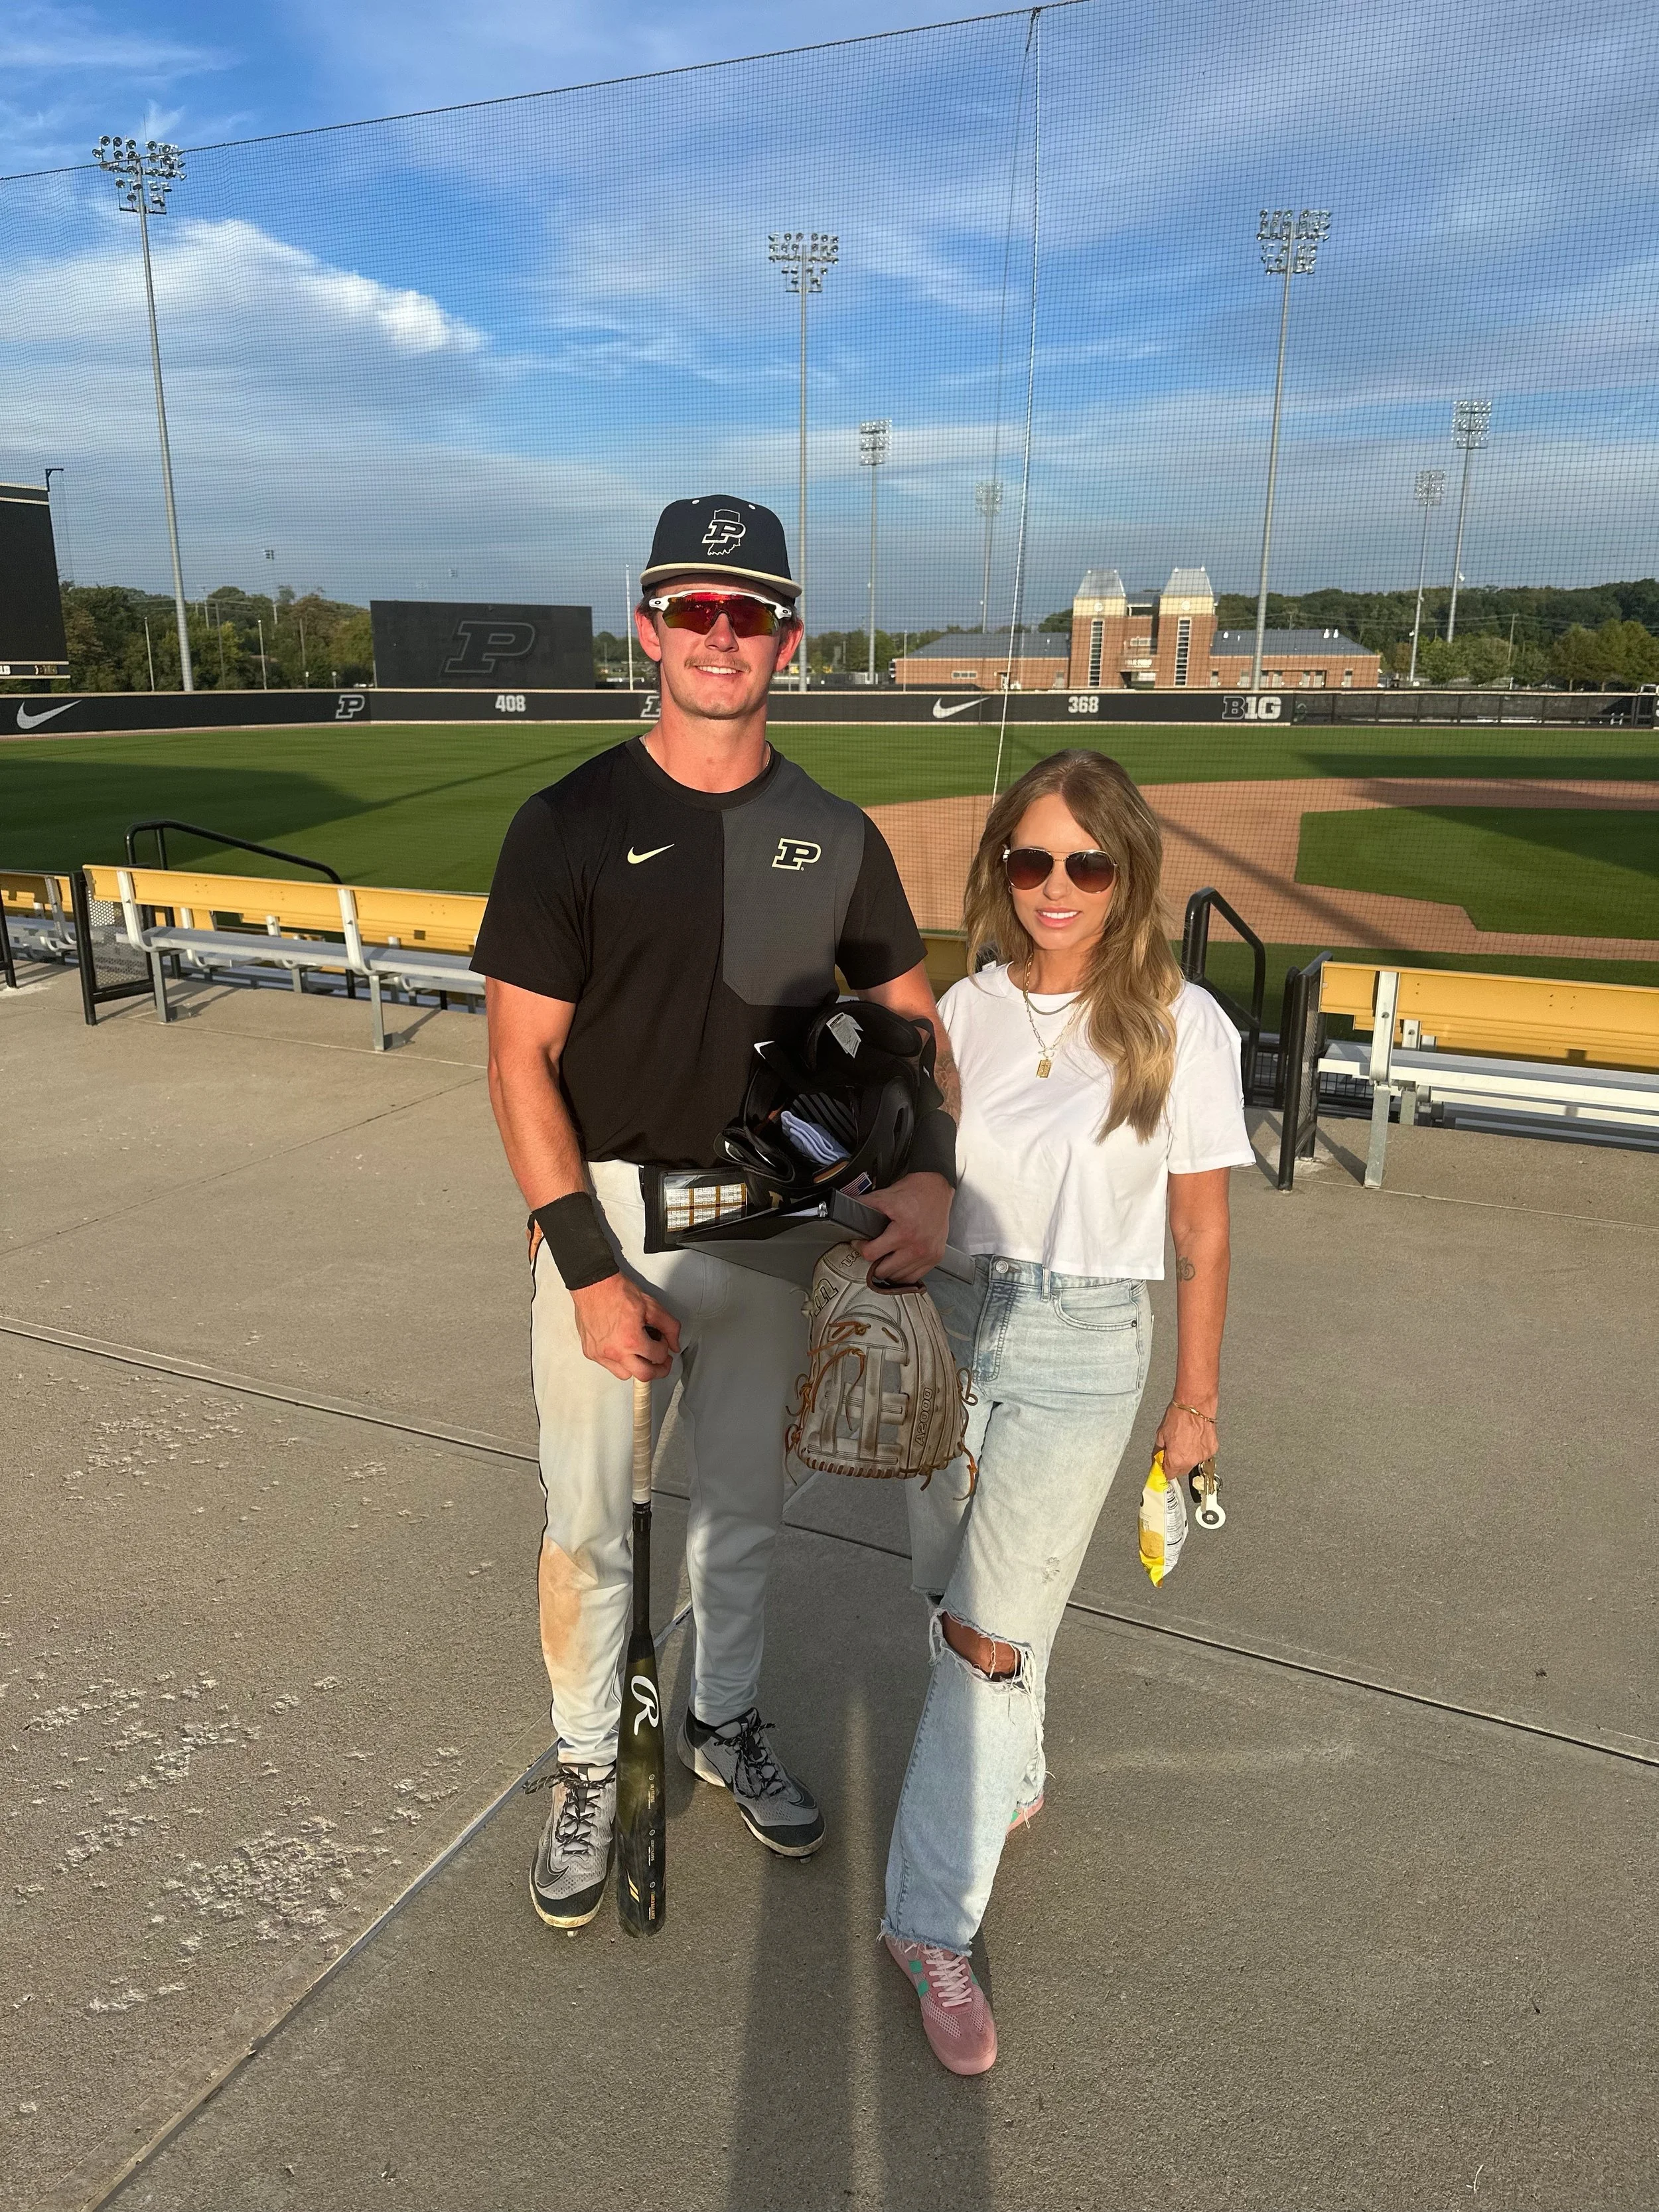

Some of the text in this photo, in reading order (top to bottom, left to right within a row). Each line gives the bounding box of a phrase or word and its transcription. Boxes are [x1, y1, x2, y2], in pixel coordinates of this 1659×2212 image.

[701, 519, 747, 544] P
[445, 621, 536, 673] P
[335, 694, 365, 719] P
[495, 695, 526, 712] 408
[1068, 696, 1099, 713] 368
[771, 838, 822, 871] P
[915, 1388, 933, 1447] A2000
